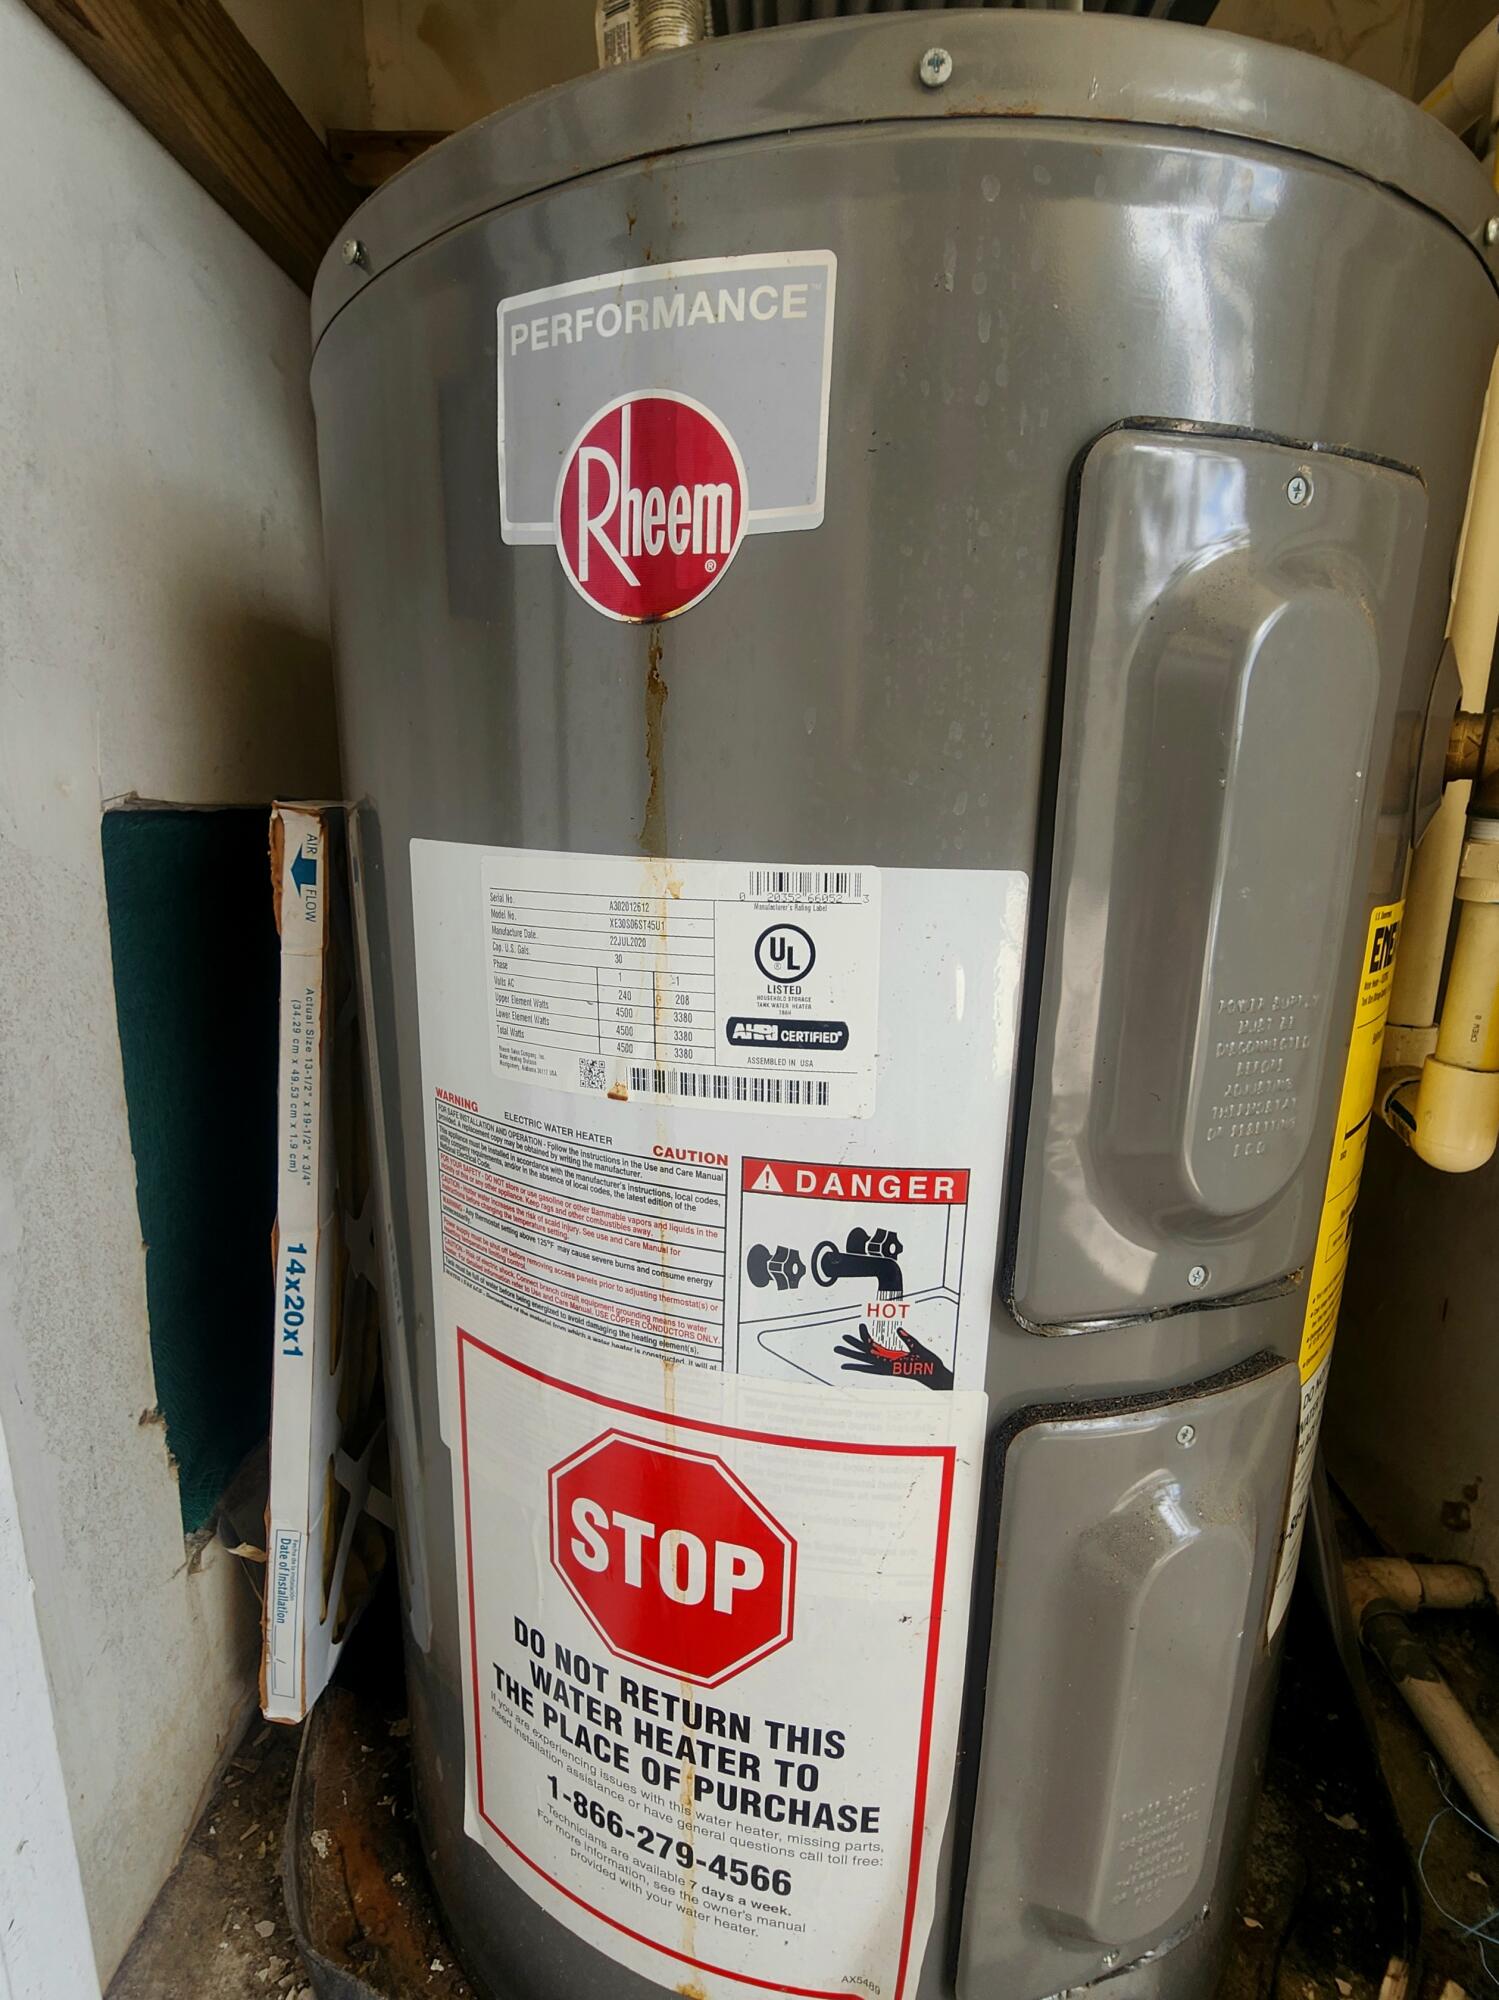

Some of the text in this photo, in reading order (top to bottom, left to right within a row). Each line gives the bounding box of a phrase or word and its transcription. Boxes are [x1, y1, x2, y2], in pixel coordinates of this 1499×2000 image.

[511, 284, 808, 356] PERFORMANCE
[578, 404, 732, 586] Rheem
[306, 833, 318, 855] AIR
[305, 889, 317, 923] FLOW
[490, 892, 504, 903] Serial
[609, 901, 649, 913] A302012612
[754, 903, 793, 911] Manufacturer's
[794, 904, 811, 913] Rating
[768, 893, 801, 903] 20352
[807, 893, 843, 903] 66052
[863, 894, 870, 903] 3
[491, 909, 517, 920] Model No.
[609, 918, 665, 931] XE30S06ST45U1
[492, 925, 522, 938] Manufacture
[610, 936, 646, 948] 22JUL2020
[614, 954, 623, 964] 30
[770, 937, 800, 970] UL
[493, 959, 680, 986] Phase 1 1
[494, 976, 690, 1006] Volts AC 240 208
[767, 984, 802, 995] LISTED
[291, 999, 302, 1034] (34.29
[305, 988, 315, 1024] Actual
[495, 992, 693, 1024] Upper Element Watts 4500 3380
[496, 1007, 693, 1042] Lower Element Watts 4500 3380
[781, 1030, 840, 1044] CERTIFIED
[291, 1039, 300, 1053] cm
[305, 1029, 314, 1053] Size
[497, 1024, 693, 1059] Total Watts 4500 3380
[303, 1057, 313, 1097] 13-1/2"
[747, 1056, 813, 1068] ASSEMBLED IN USA
[290, 1069, 300, 1099] 49.53
[290, 1103, 297, 1118] cm
[436, 1087, 478, 1112] WARNING
[289, 1134, 298, 1150] 1.9
[504, 1111, 613, 1145] ELECTRIC WATER HEATER
[448, 1107, 459, 1119] SAFE
[460, 1111, 494, 1131] INSTALLATION
[496, 1125, 507, 1136] AND
[508, 1128, 542, 1147] OPERATION
[547, 1141, 568, 1154] Follow
[569, 1147, 579, 1156] the
[581, 1149, 620, 1166] instructions
[622, 1158, 628, 1167] in
[630, 1160, 642, 1169] the
[644, 1161, 658, 1172] Use
[660, 1165, 673, 1174] and
[675, 1167, 693, 1177] Care
[695, 1170, 723, 1181] Manual
[653, 1145, 728, 1166] CAUTION
[288, 1153, 297, 1173] cm)
[302, 1164, 311, 1186] 3/4"
[796, 1170, 954, 1199] DANGER
[283, 1243, 307, 1357] 14x20x1
[867, 1303, 910, 1319] HOT
[893, 1363, 933, 1375] BURN
[570, 1497, 764, 1615] STOP
[277, 1538, 291, 1624] Date of Installation
[514, 1615, 845, 1759] DO NOT RETURN THIS
[529, 1659, 819, 1792] WATER HEATER TO
[493, 1662, 880, 1834] THE PLACE OF PURCHASE
[491, 1705, 884, 1866] need installation assistance or have general questions call toll free:
[499, 1701, 513, 1718] you
[515, 1713, 530, 1731] are
[533, 1727, 597, 1776] experiencing
[599, 1768, 637, 1795] issues
[640, 1789, 665, 1806] with
[669, 1799, 691, 1816] this
[696, 1811, 731, 1828] water
[736, 1820, 782, 1842] heater,
[787, 1834, 840, 1852] missing
[845, 1842, 884, 1853] parts,
[547, 1775, 792, 1896] 1-866-279-4566
[537, 1808, 806, 1933] For more information, see the owner's manual
[547, 1803, 792, 1916] Technicians are available 7 days a week.
[570, 1847, 759, 1937] provided with your water heater.
